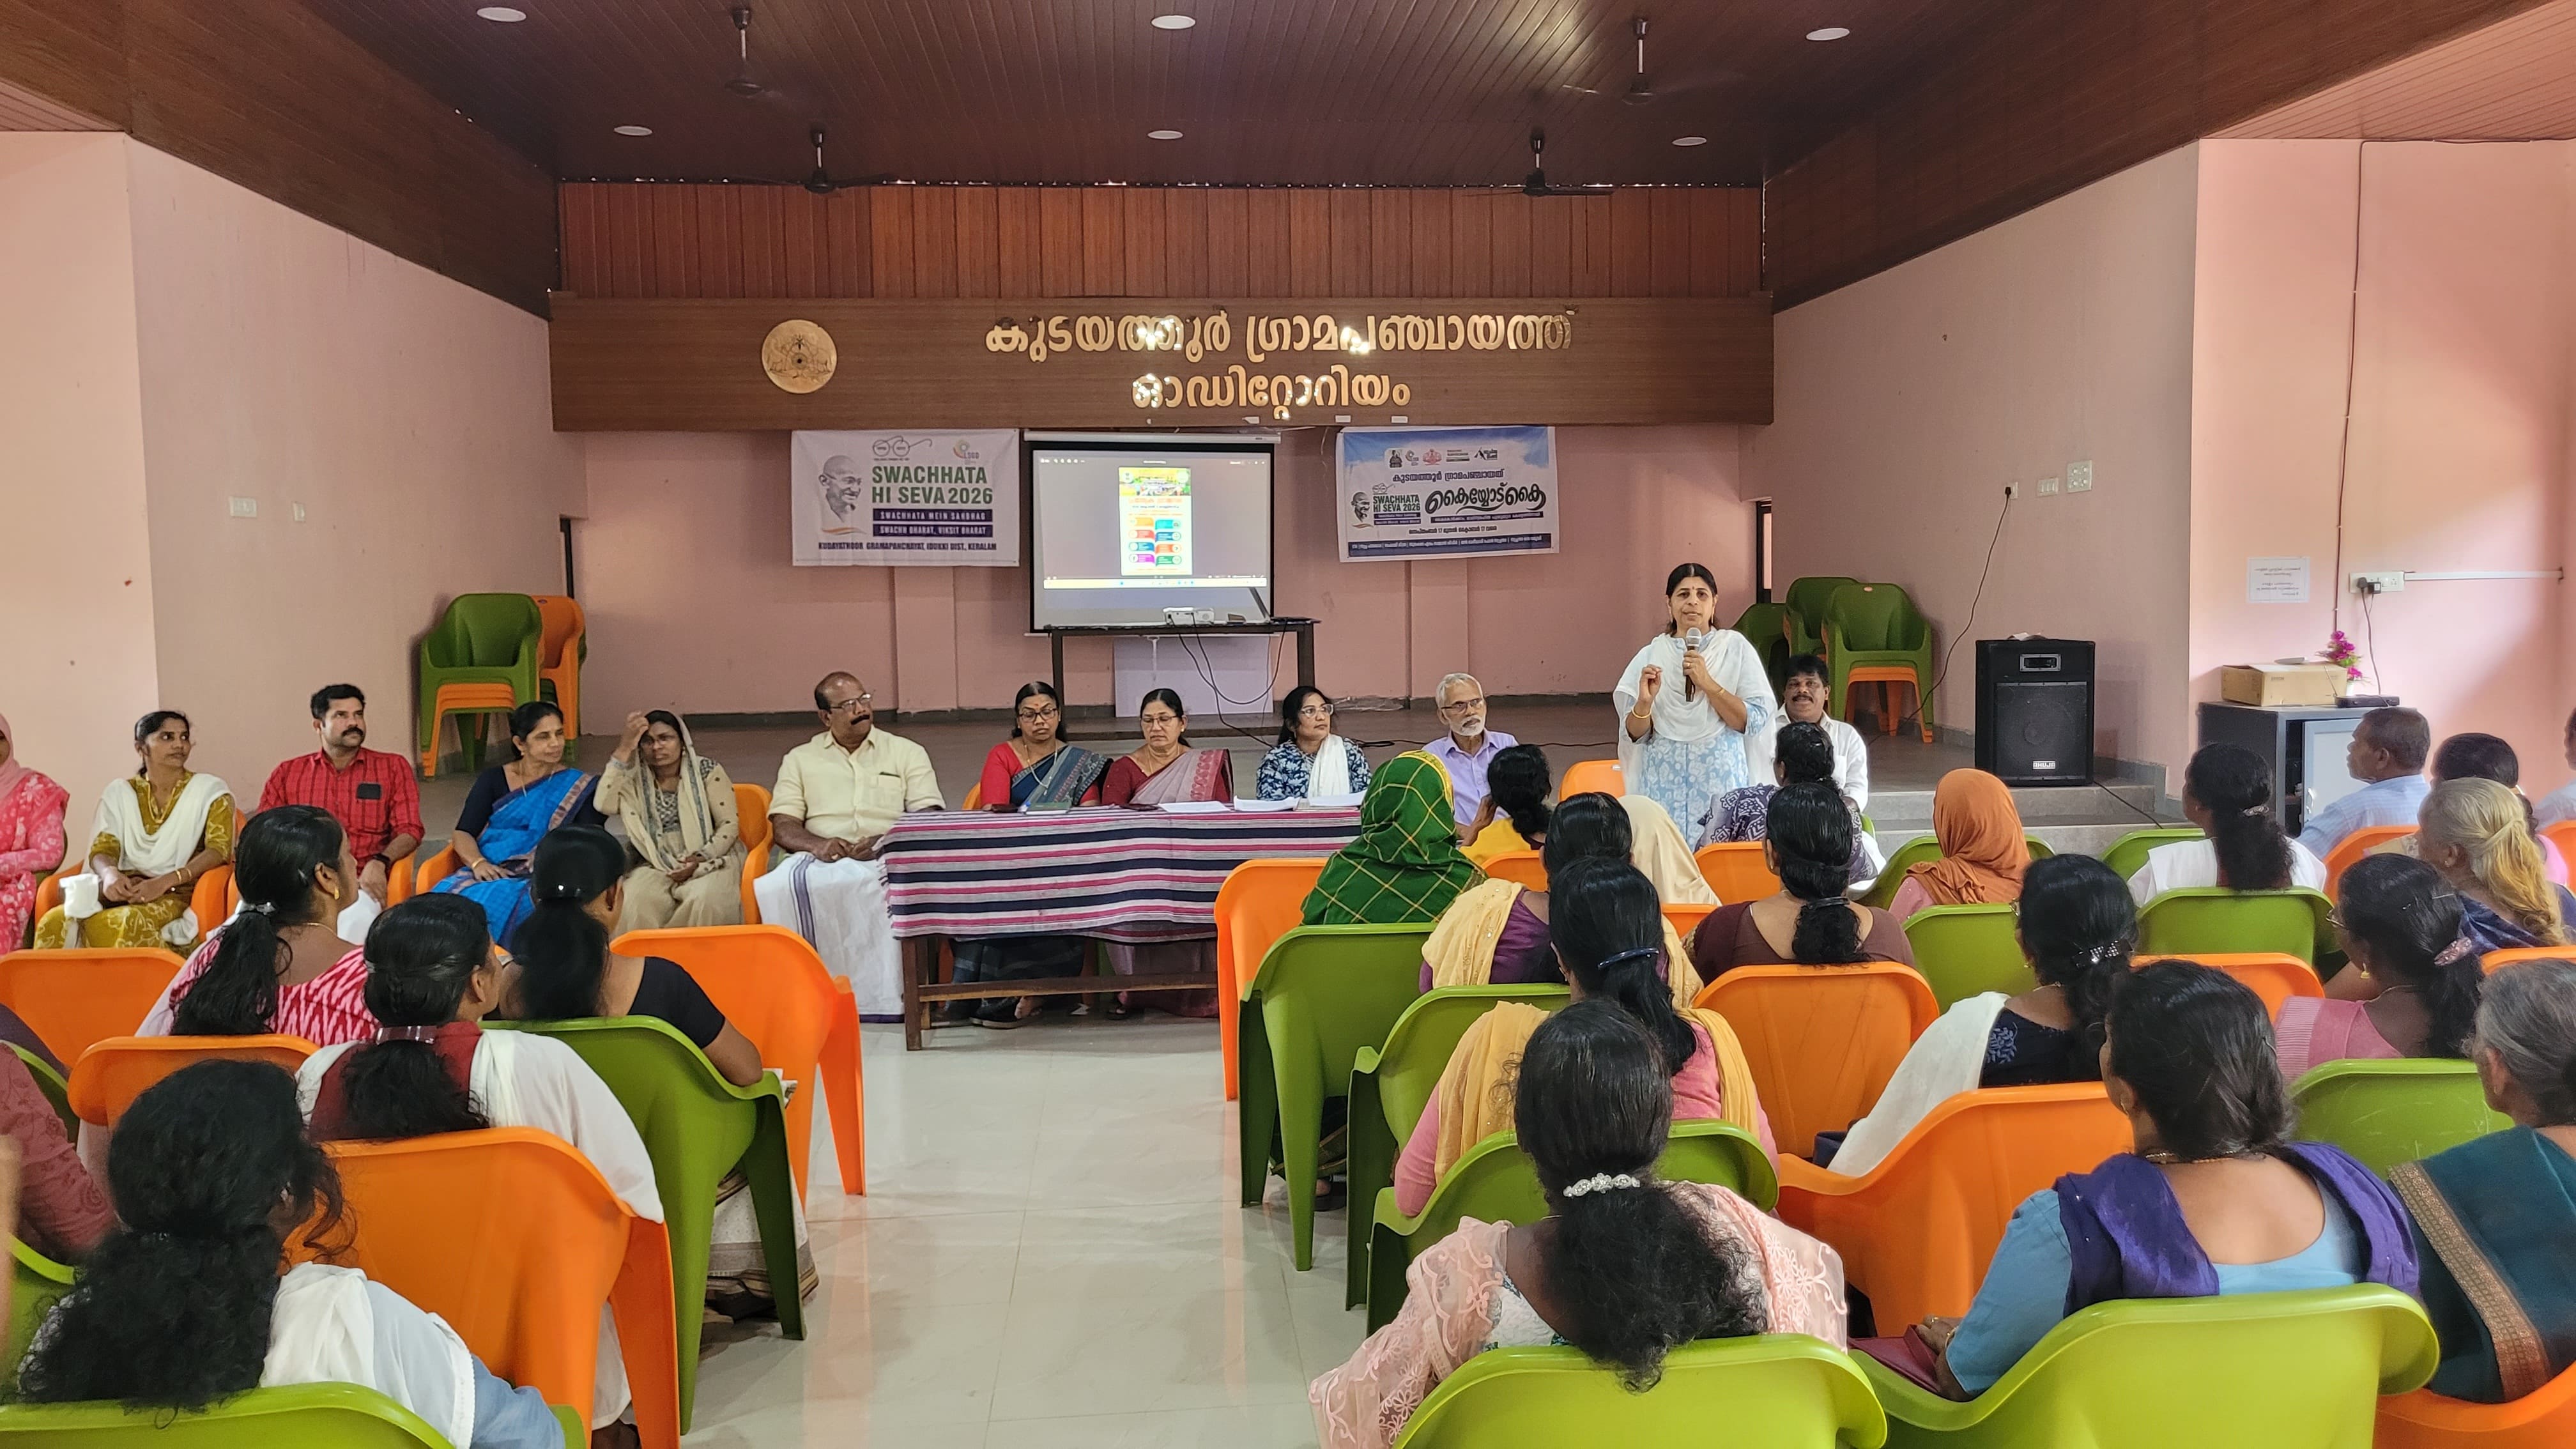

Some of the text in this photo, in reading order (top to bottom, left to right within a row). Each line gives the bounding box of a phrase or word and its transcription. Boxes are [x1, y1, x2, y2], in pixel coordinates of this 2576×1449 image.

[986, 306, 1231, 363] കുടയത്തൂർ
[1132, 364, 1411, 420] ഓഡിറ്റോറിയം
[872, 466, 987, 484] SWACHHATA
[872, 486, 993, 504] HI SEVA 2026
[1373, 494, 1420, 504] SWACHHATA
[880, 511, 925, 519] SWACHHATA
[1373, 504, 1381, 512] HI
[1383, 503, 1401, 512] SEVA
